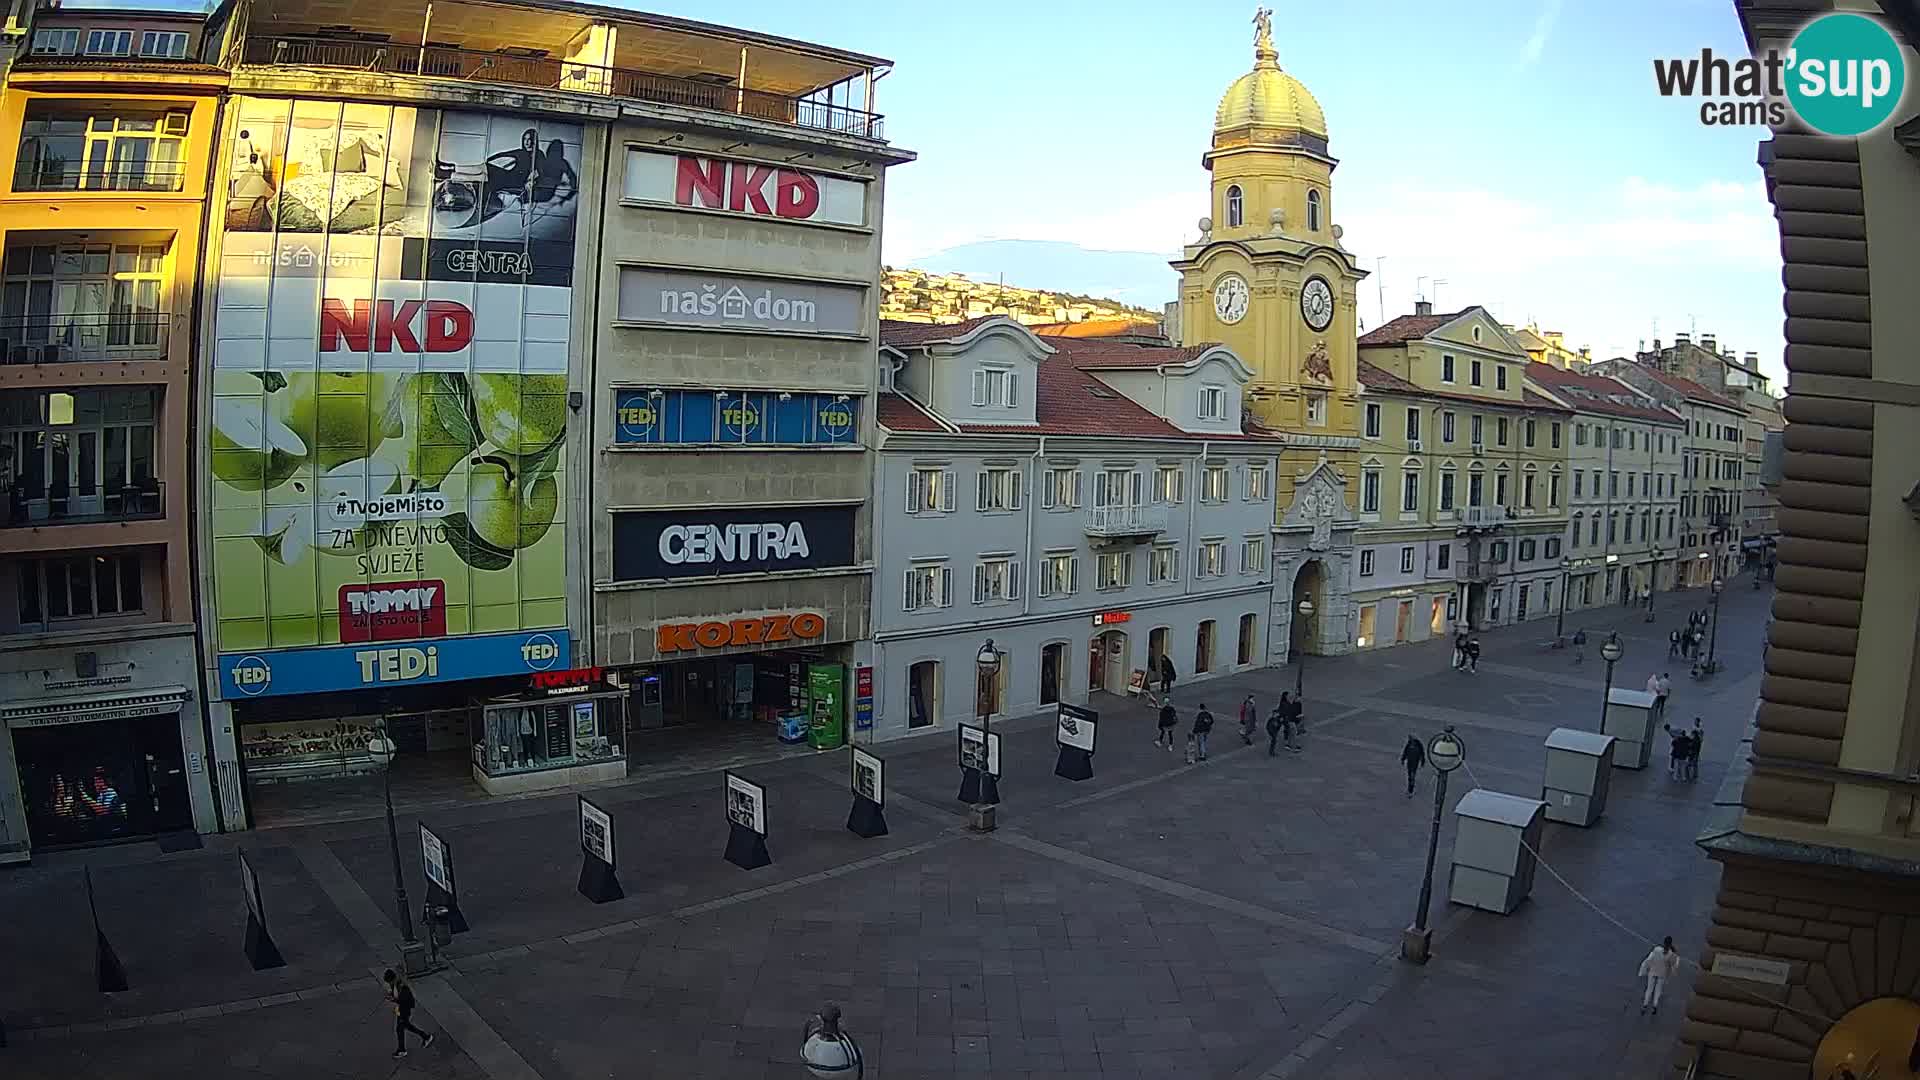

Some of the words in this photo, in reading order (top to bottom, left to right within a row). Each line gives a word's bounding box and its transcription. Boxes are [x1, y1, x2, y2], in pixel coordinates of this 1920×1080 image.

[675, 155, 820, 219] NKD
[446, 249, 534, 275] CENTRA
[661, 283, 717, 316] naš
[753, 290, 816, 323] dom
[319, 298, 476, 353] NKD
[618, 408, 657, 426] TEDi
[722, 409, 759, 426] TEDi
[819, 411, 852, 427] TEDi
[336, 491, 444, 518] #TvojeMisto
[331, 528, 356, 550] ZA
[364, 524, 449, 549] DNEVNO
[658, 521, 810, 565] CENTRA
[357, 551, 425, 577] SVJEŽE
[347, 586, 438, 615] TOMMY
[657, 612, 826, 653] KORZO
[355, 646, 439, 684] TEDi
[520, 643, 558, 661] TEDi
[231, 666, 272, 685] TEDi
